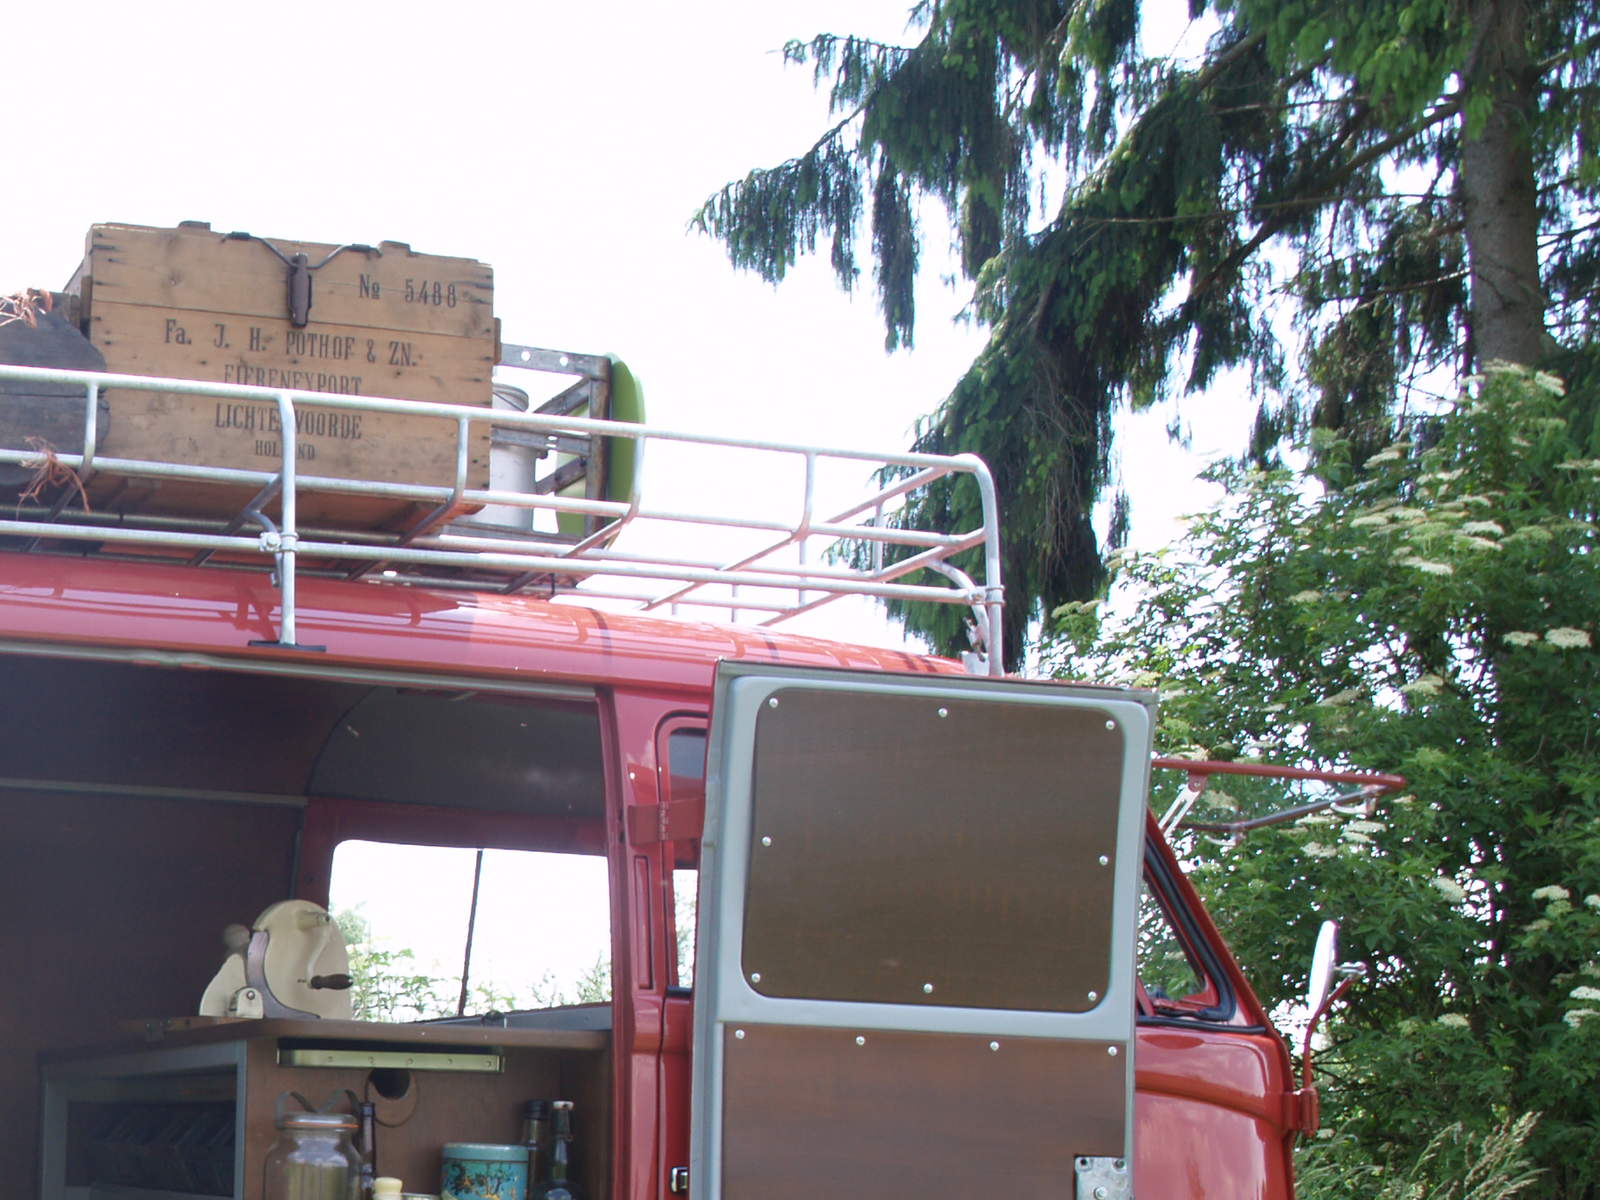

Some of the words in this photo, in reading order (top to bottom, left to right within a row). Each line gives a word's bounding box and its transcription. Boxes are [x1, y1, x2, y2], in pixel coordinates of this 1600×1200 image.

[403, 278, 458, 308] 5488
[163, 317, 192, 346] Fa.
[212, 322, 230, 350] J.
[285, 330, 356, 361] POTHOF
[366, 338, 377, 364] &
[214, 402, 363, 441] LICHTEVOORDE
[254, 439, 317, 461] HOLND
